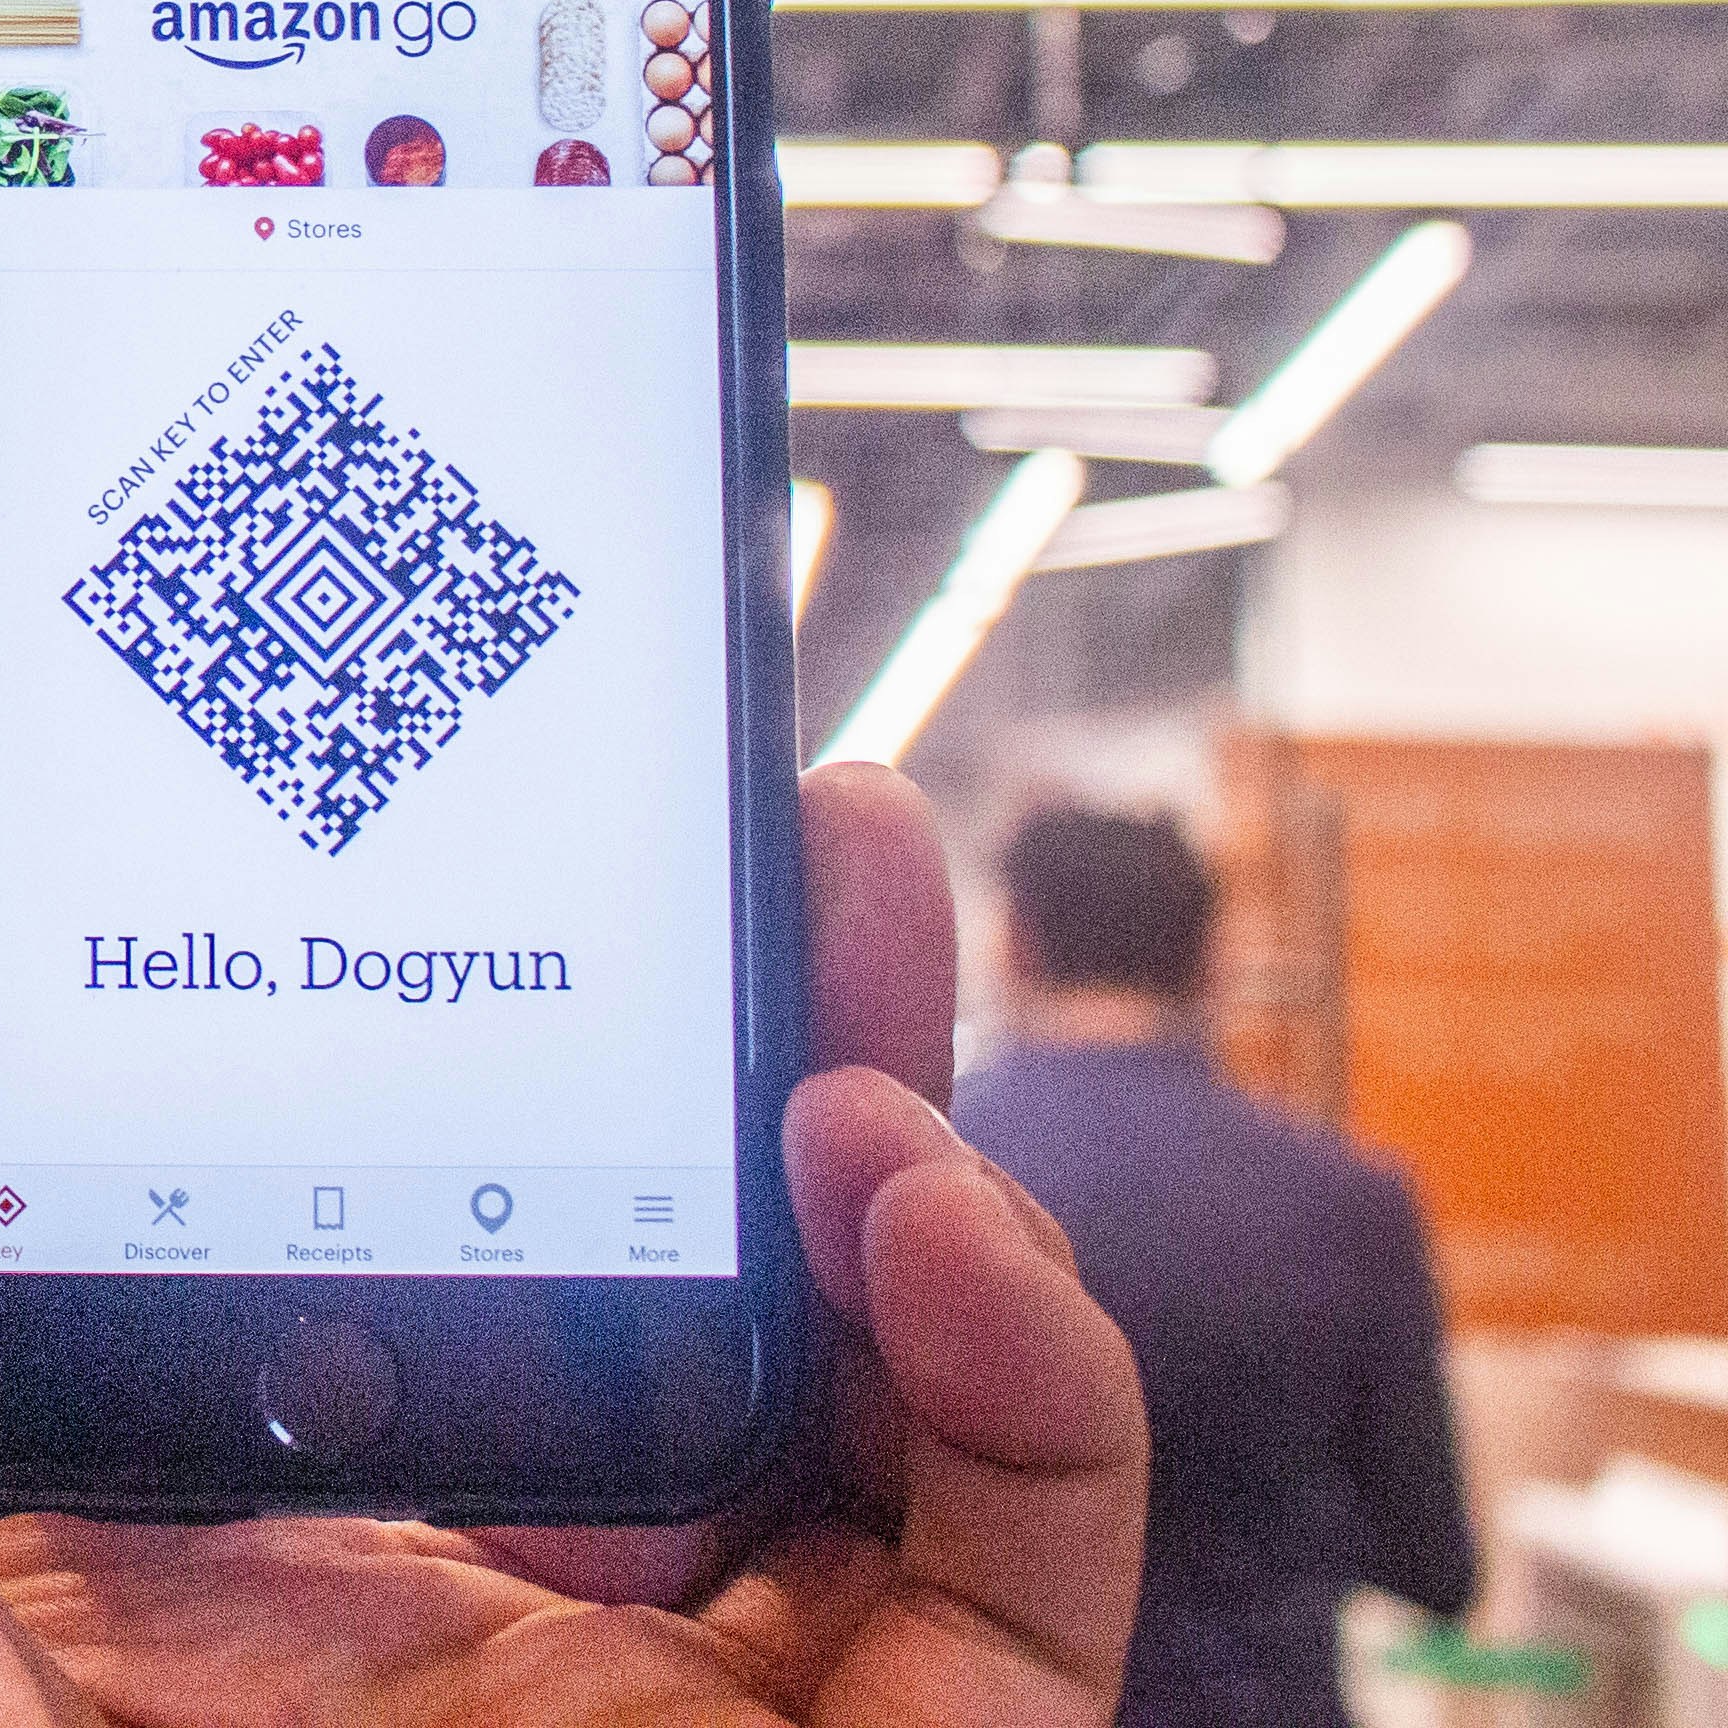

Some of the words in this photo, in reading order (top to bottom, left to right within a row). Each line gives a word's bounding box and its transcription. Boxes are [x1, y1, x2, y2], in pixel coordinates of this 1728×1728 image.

[151, 0, 381, 43] amazon
[393, 0, 477, 58] go
[287, 218, 363, 240] Stores
[87, 456, 156, 526] SCAN
[149, 411, 197, 463] KEY
[191, 381, 231, 416] TO
[226, 308, 305, 385] ENTER
[84, 932, 278, 998] Hello,
[300, 936, 573, 1004] Dogyun
[124, 1242, 212, 1261] Discover
[286, 1243, 373, 1265] Receipts
[459, 1244, 525, 1263] Stores
[628, 1245, 681, 1263] More
